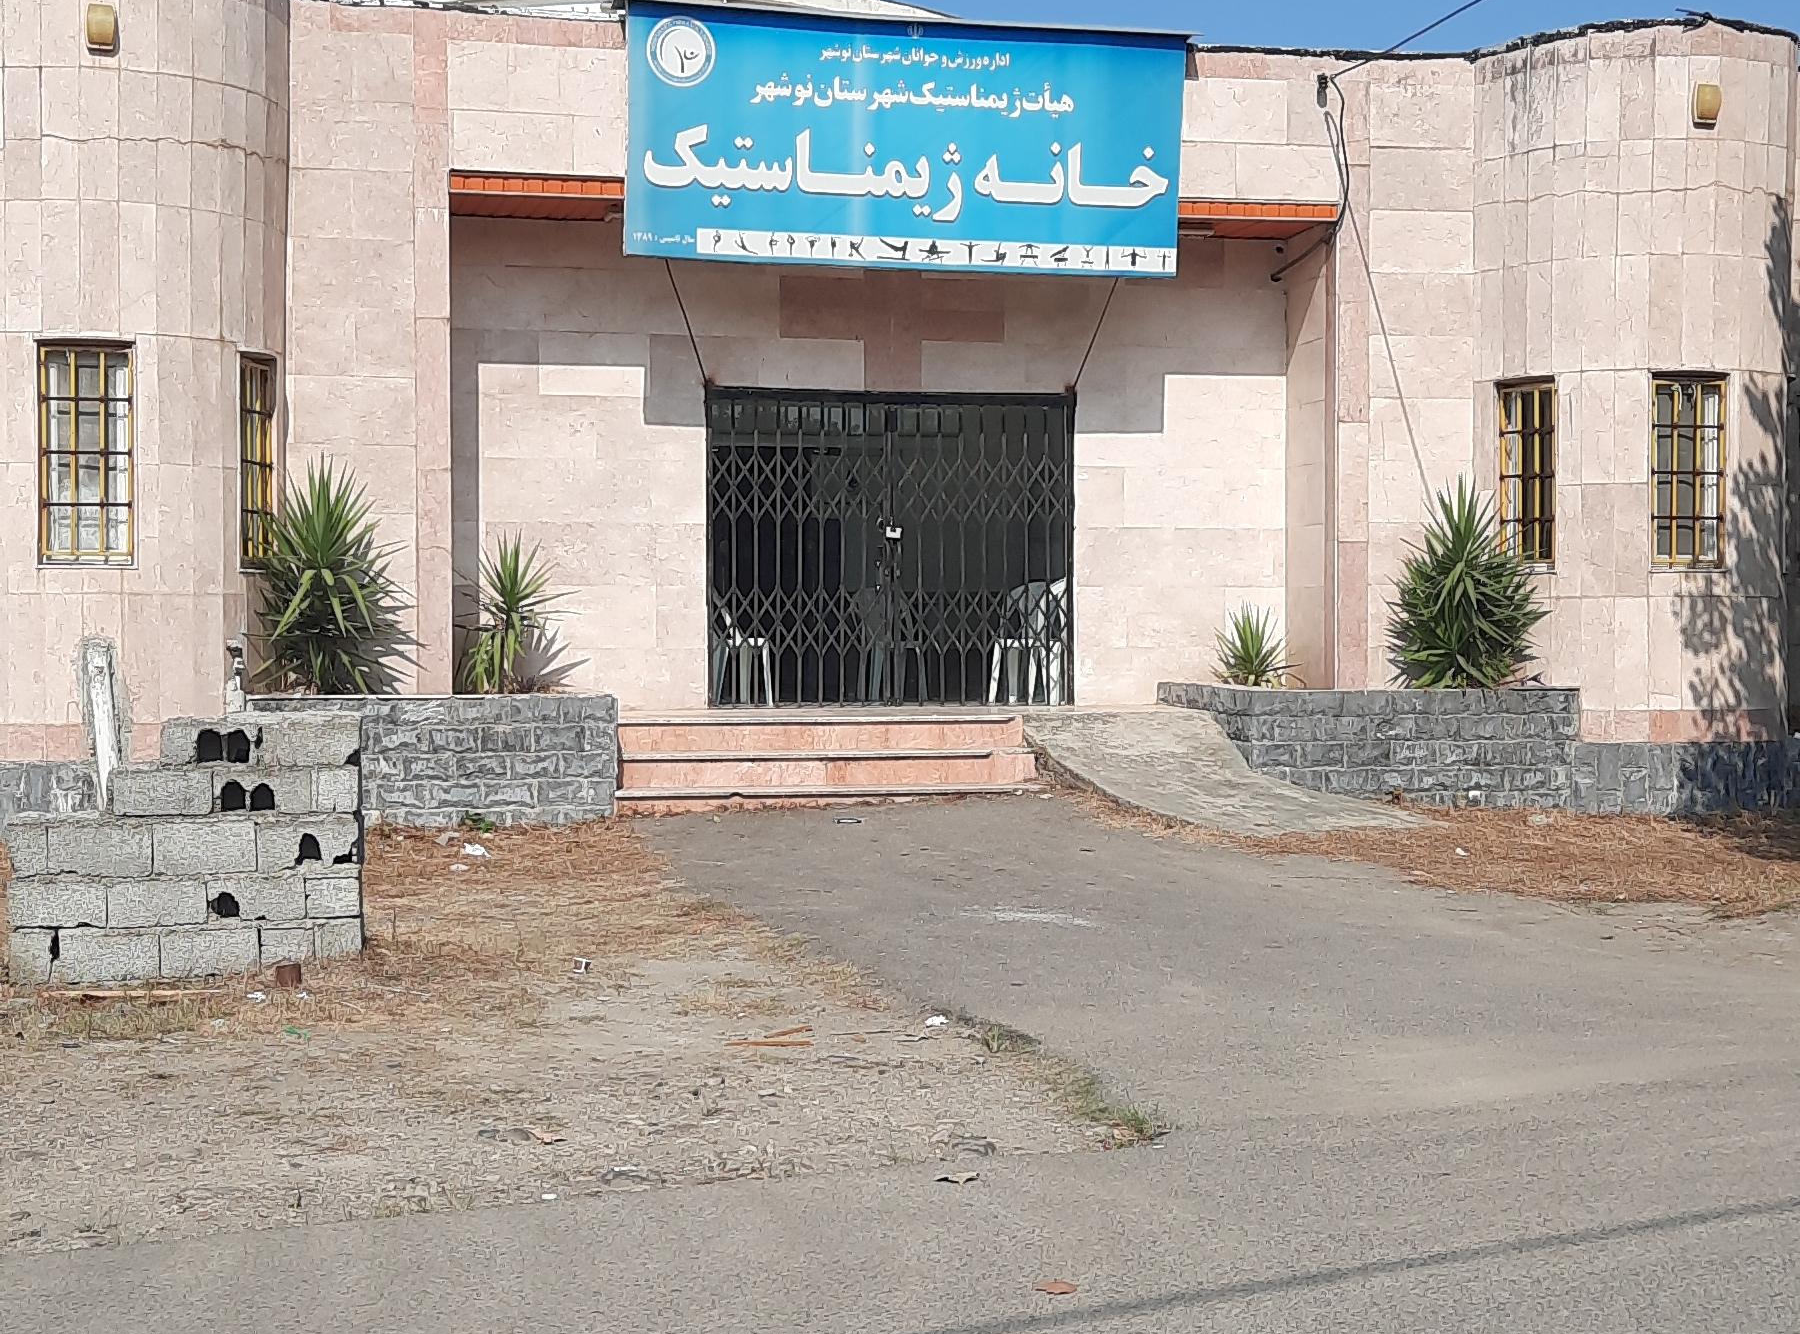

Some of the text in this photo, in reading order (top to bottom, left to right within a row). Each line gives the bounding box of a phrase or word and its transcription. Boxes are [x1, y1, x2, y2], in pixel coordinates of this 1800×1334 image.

[819, 44, 1010, 70] اداره ورزش و جوانان شهرستان نوشهر
[750, 72, 814, 107] نوشهر
[813, 76, 909, 110] شهرستان
[909, 81, 1021, 118] ژیمناستیک
[643, 123, 1169, 223] خانه ژیمناستیک
[682, 234, 696, 244] سال
